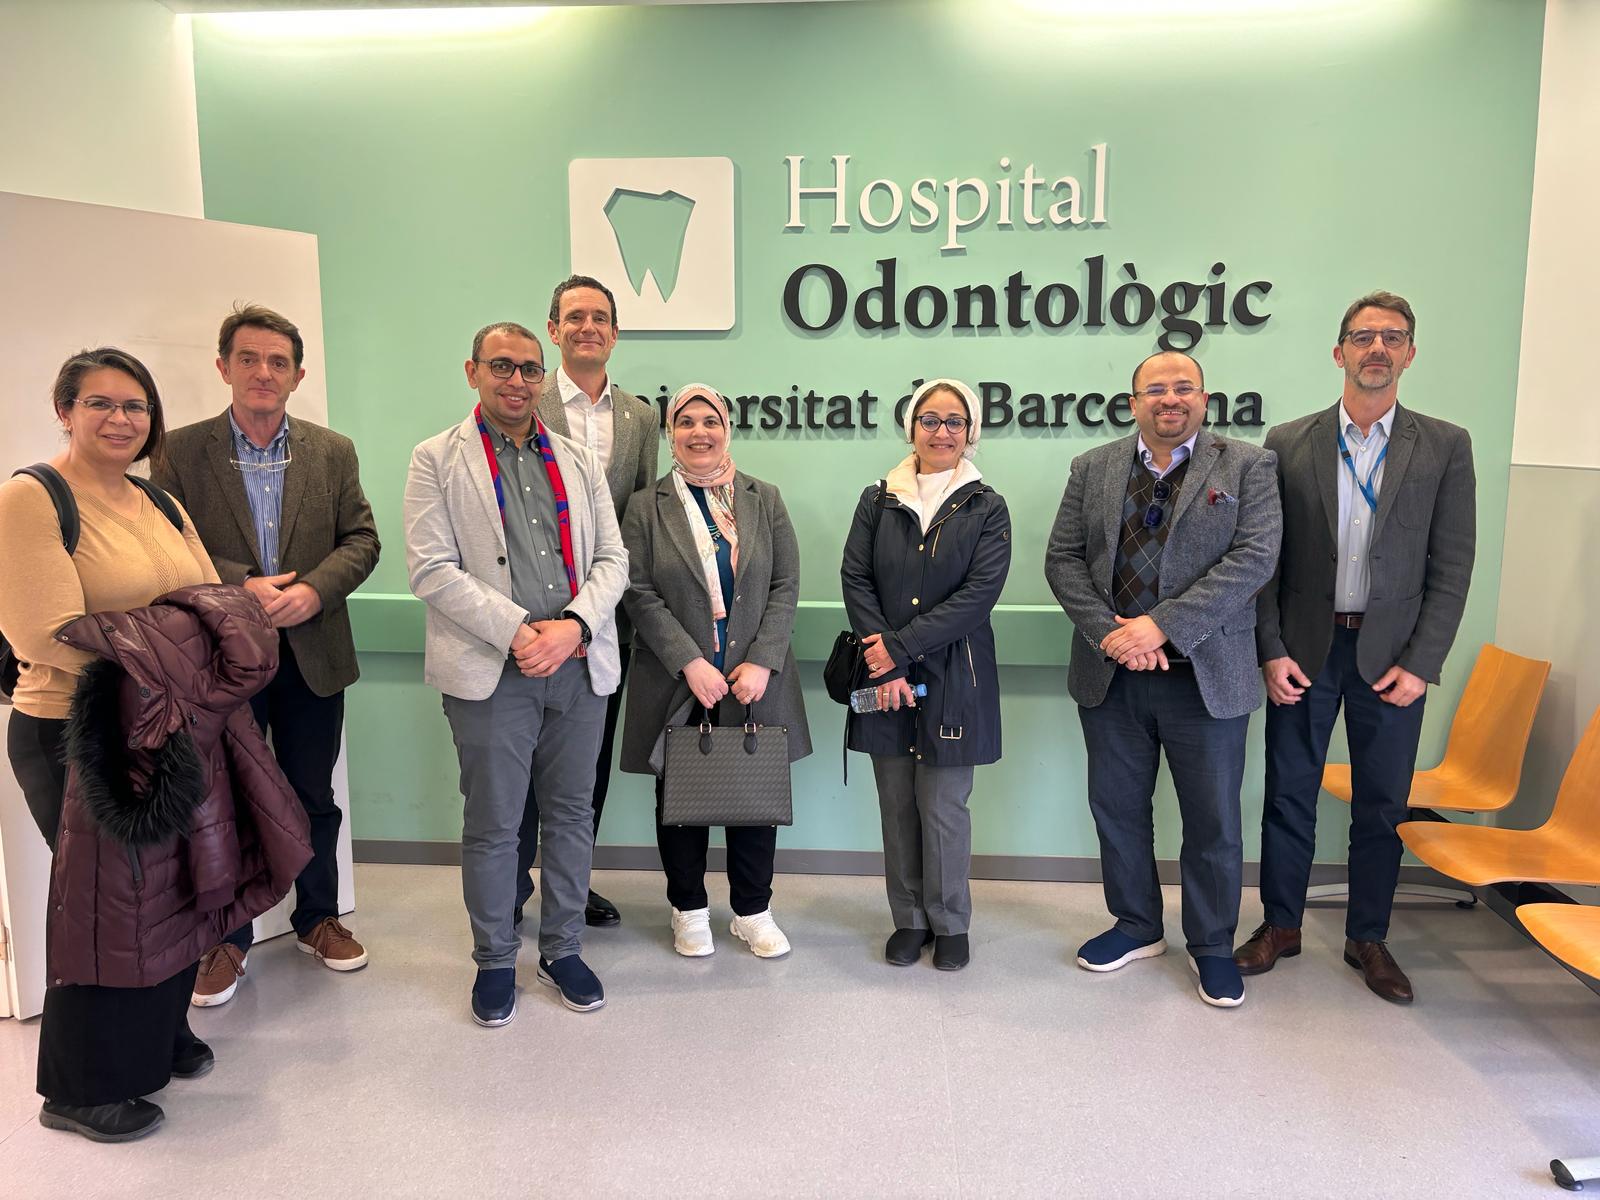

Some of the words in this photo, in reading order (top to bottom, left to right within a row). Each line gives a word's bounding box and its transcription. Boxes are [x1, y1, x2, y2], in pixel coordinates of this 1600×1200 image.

[784, 143, 1109, 251] Hospital
[783, 256, 1273, 352] Odontològic
[612, 384, 878, 430] irsitat
[979, 382, 1266, 429] Barcena
